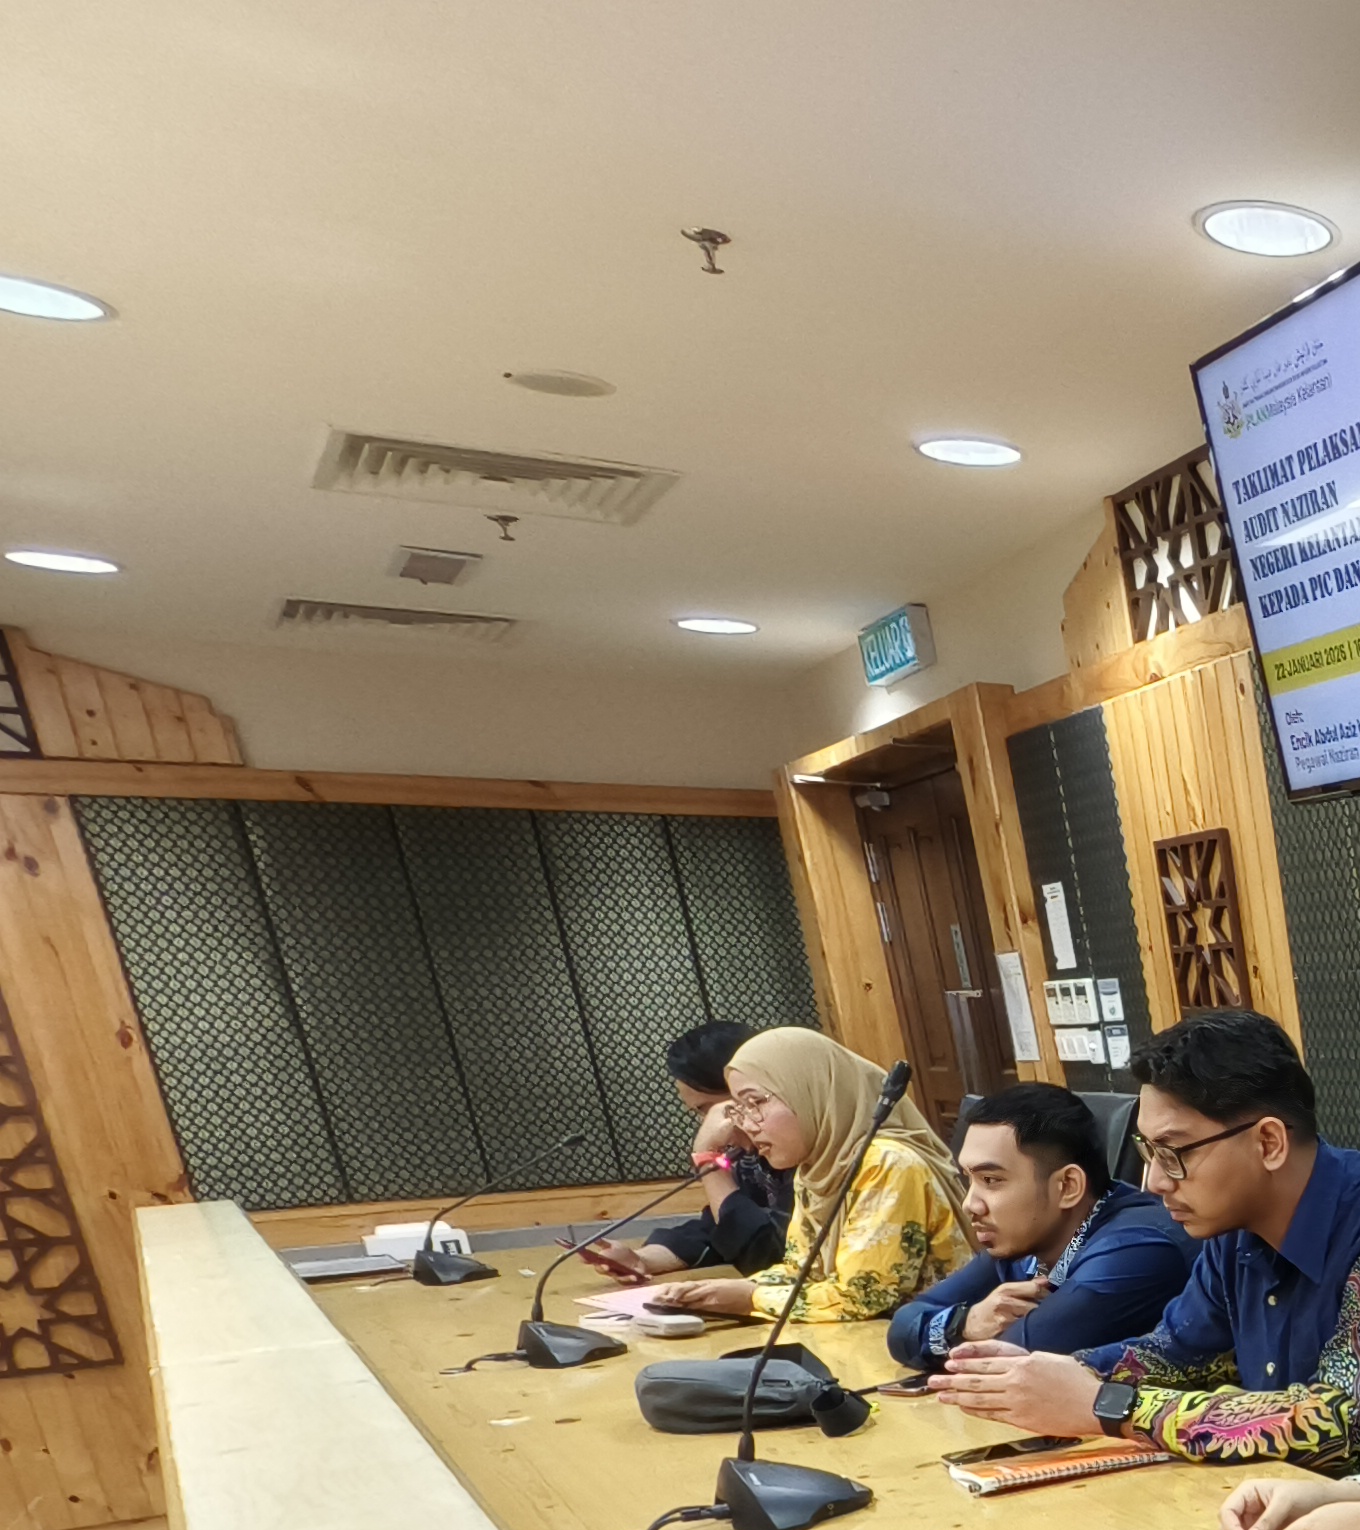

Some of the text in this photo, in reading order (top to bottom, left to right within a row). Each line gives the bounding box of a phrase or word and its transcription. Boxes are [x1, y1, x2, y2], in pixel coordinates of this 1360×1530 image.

[1232, 455, 1296, 504] TAKLIMAT
[1243, 480, 1339, 543] AUDIT NAZIRAN
[1249, 543, 1297, 581] NEGERI
[1258, 581, 1309, 618] KEPADA
[1309, 571, 1333, 601] PIC
[860, 621, 905, 677] KELUAR
[1285, 651, 1325, 676] JANUARI
[1324, 644, 1347, 666] 2026
[1290, 731, 1314, 751] Encik
[1314, 723, 1339, 746] Abdul
[1339, 721, 1358, 740] Aziz
